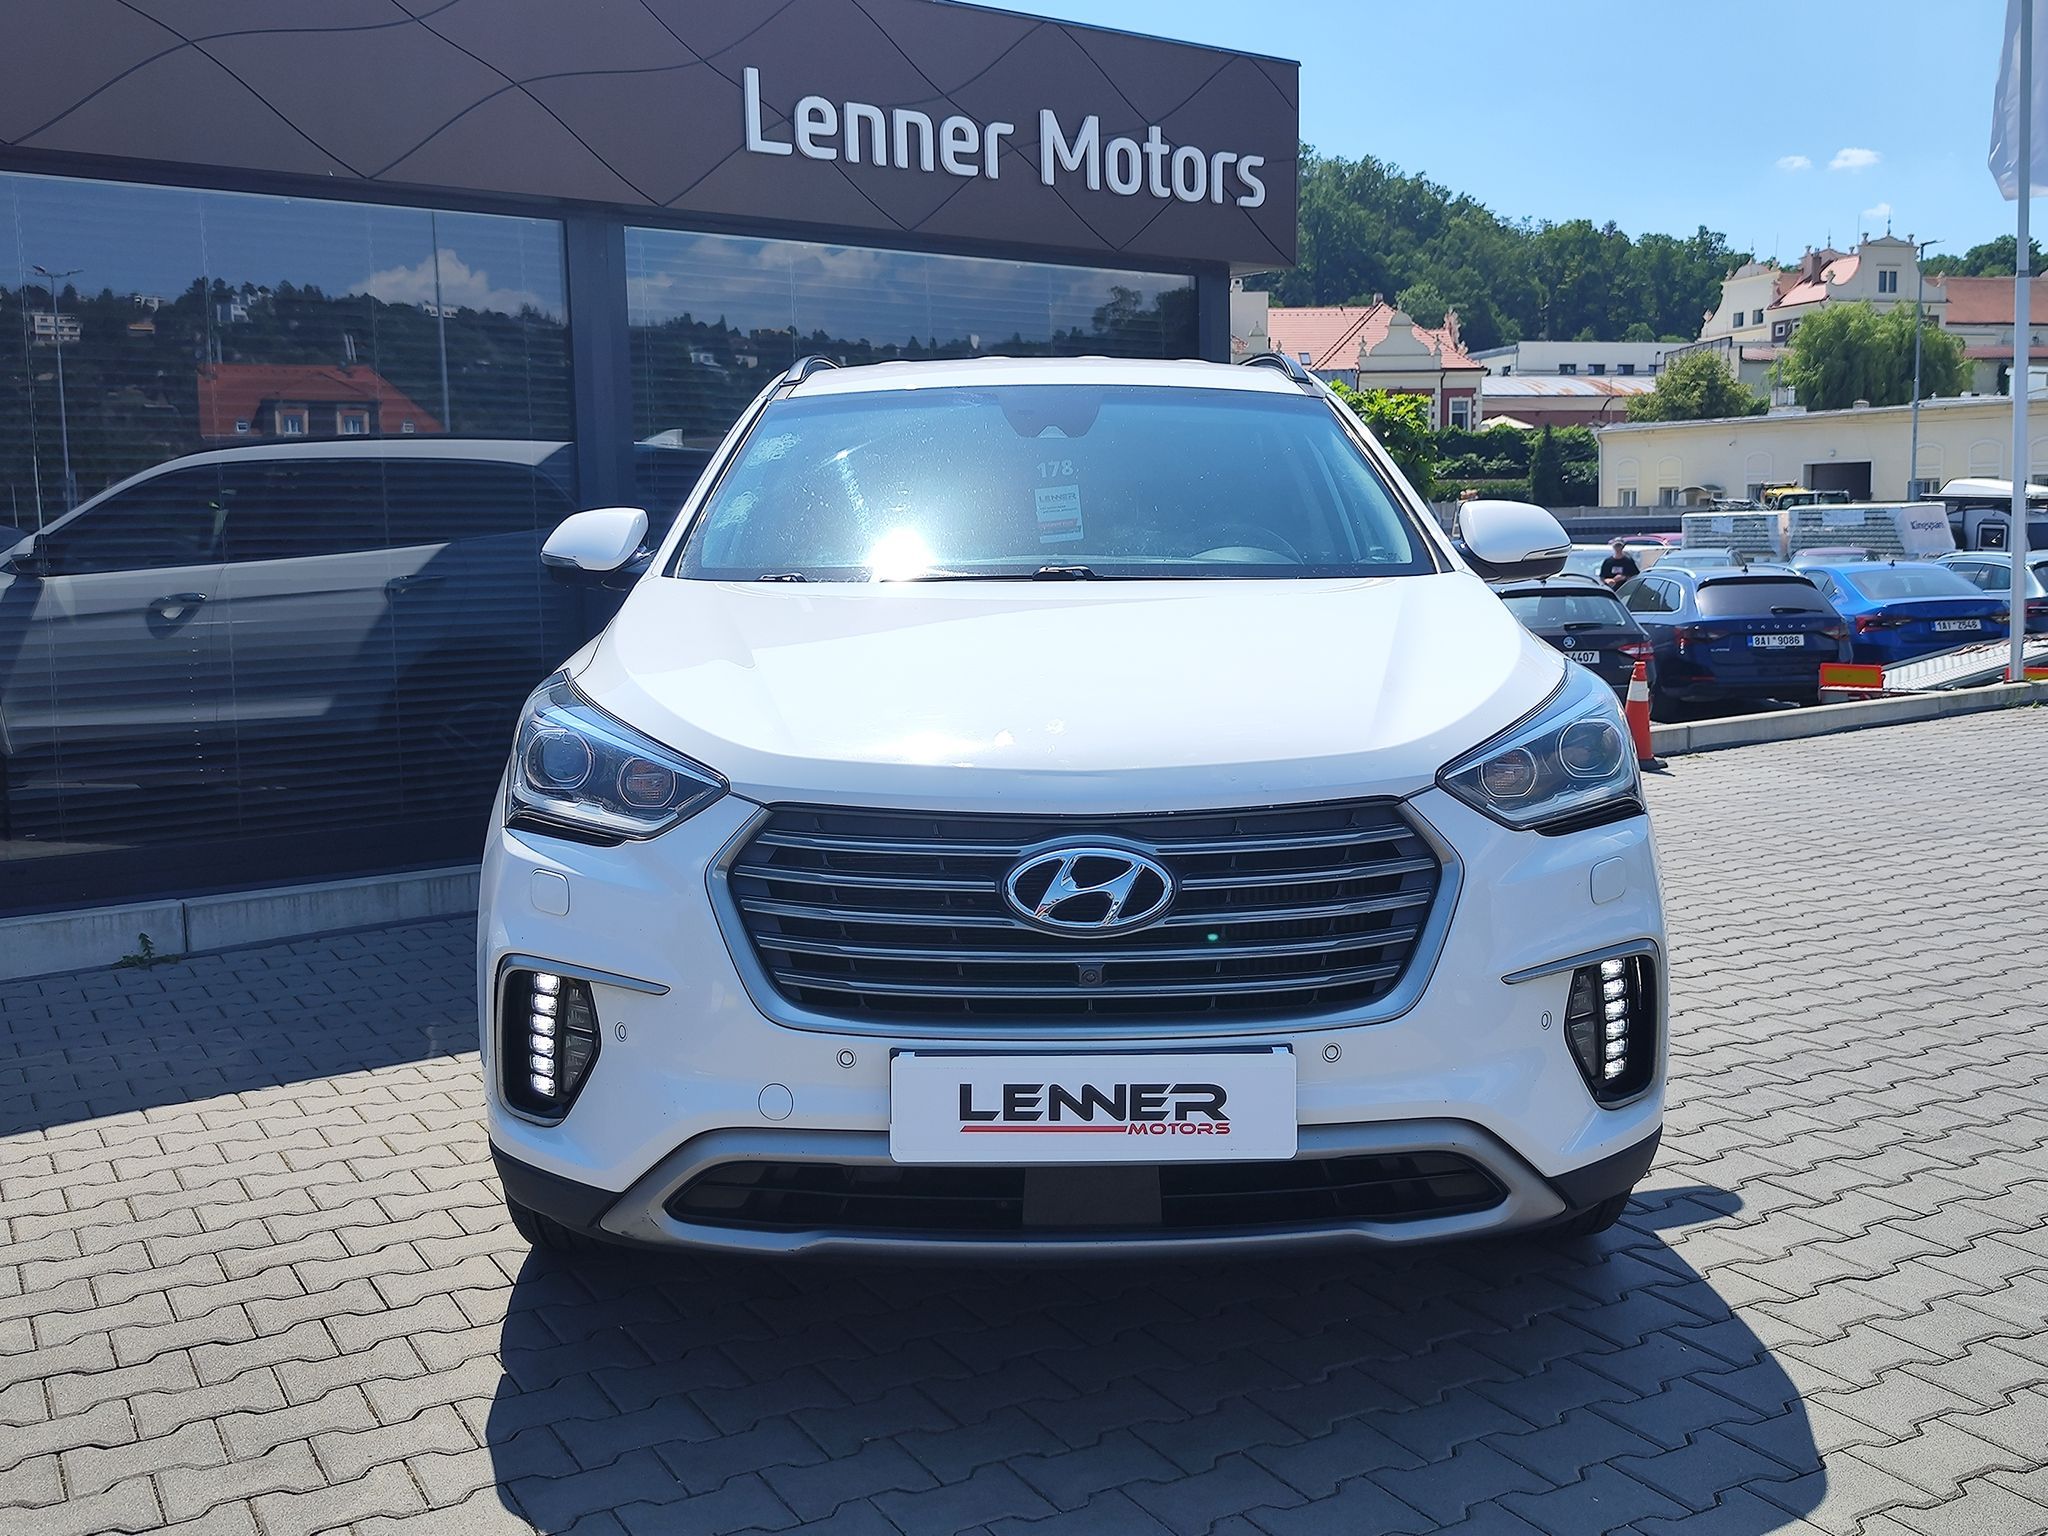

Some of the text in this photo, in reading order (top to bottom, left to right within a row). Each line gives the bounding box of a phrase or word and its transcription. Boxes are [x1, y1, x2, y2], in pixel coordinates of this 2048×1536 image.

[743, 66, 1266, 208] Lenner Motors
[1037, 459, 1074, 478] 178
[1754, 635, 1800, 646] 8AI 9086
[959, 1083, 1230, 1122] LENNER
[1127, 1122, 1231, 1135] MOTORS
